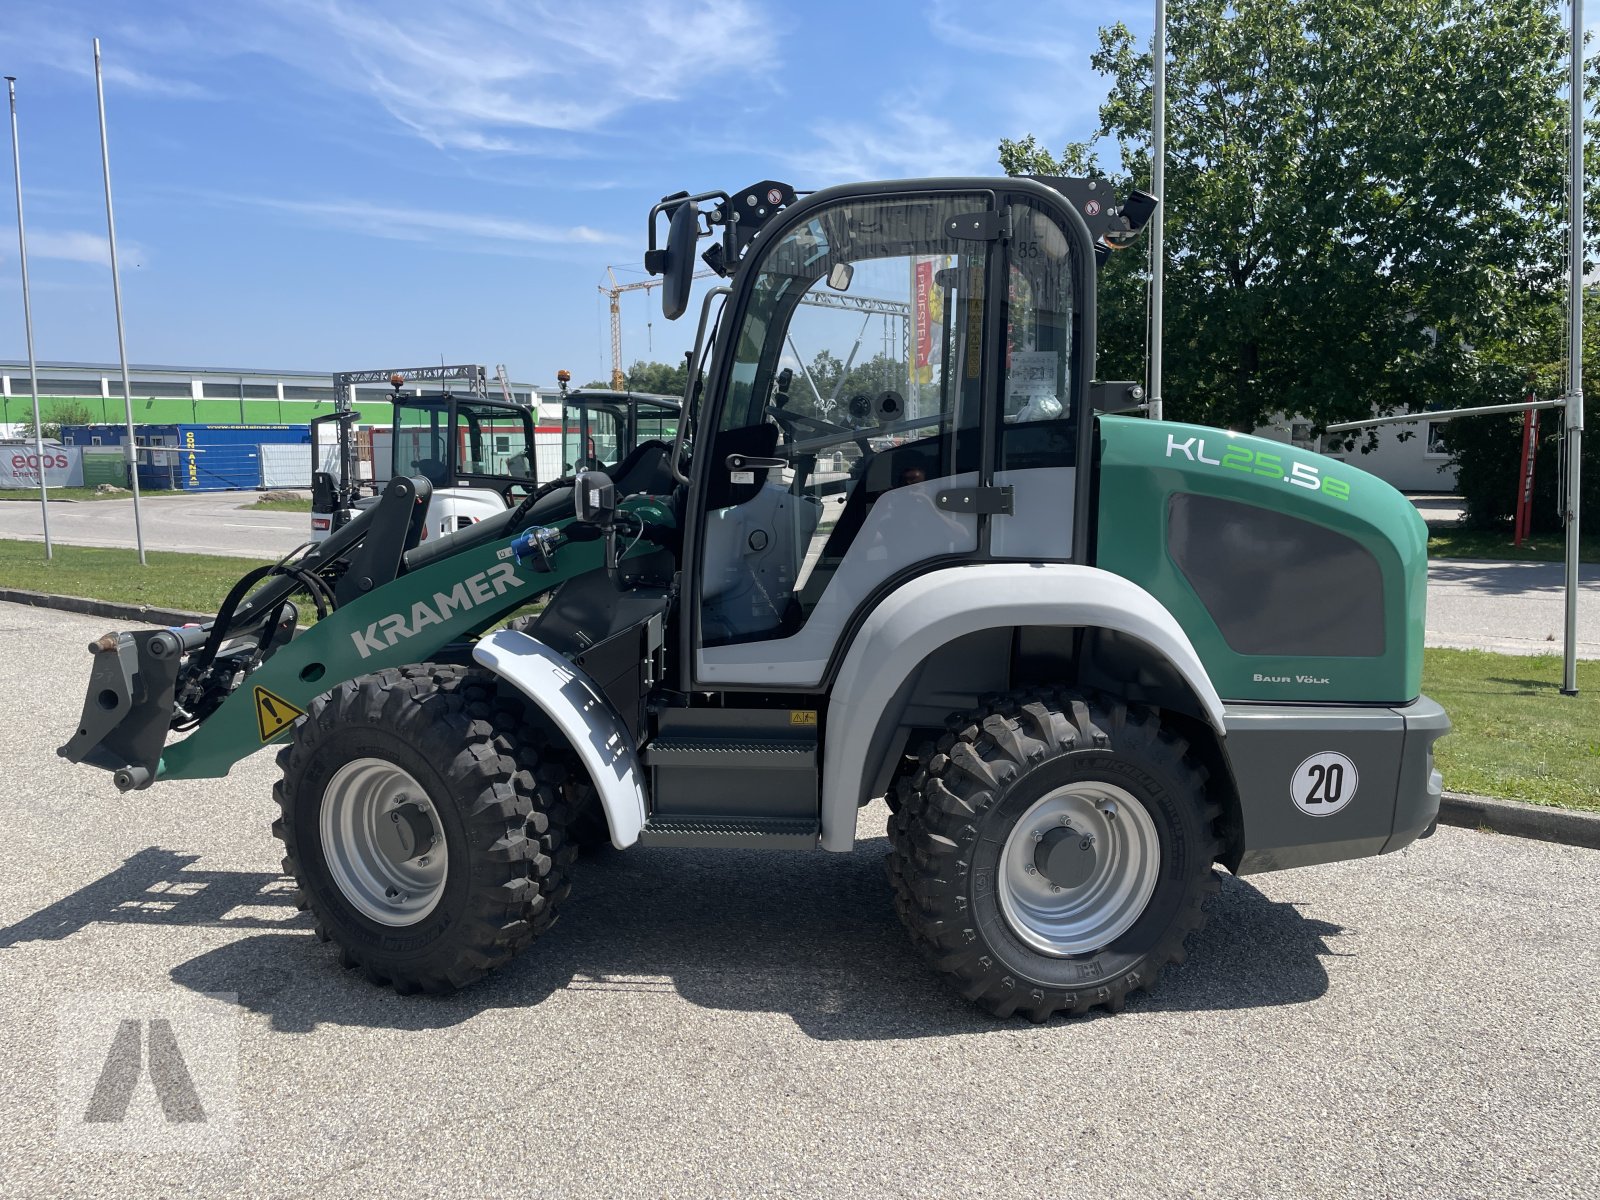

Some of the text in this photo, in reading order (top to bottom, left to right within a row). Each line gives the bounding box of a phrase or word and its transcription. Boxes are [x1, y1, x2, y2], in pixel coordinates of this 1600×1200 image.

[1018, 241, 1038, 259] 85
[11, 454, 69, 471] eqos
[1165, 433, 1350, 501] KL25.5e
[351, 562, 526, 659] KRAMER
[1305, 763, 1343, 804] 20
